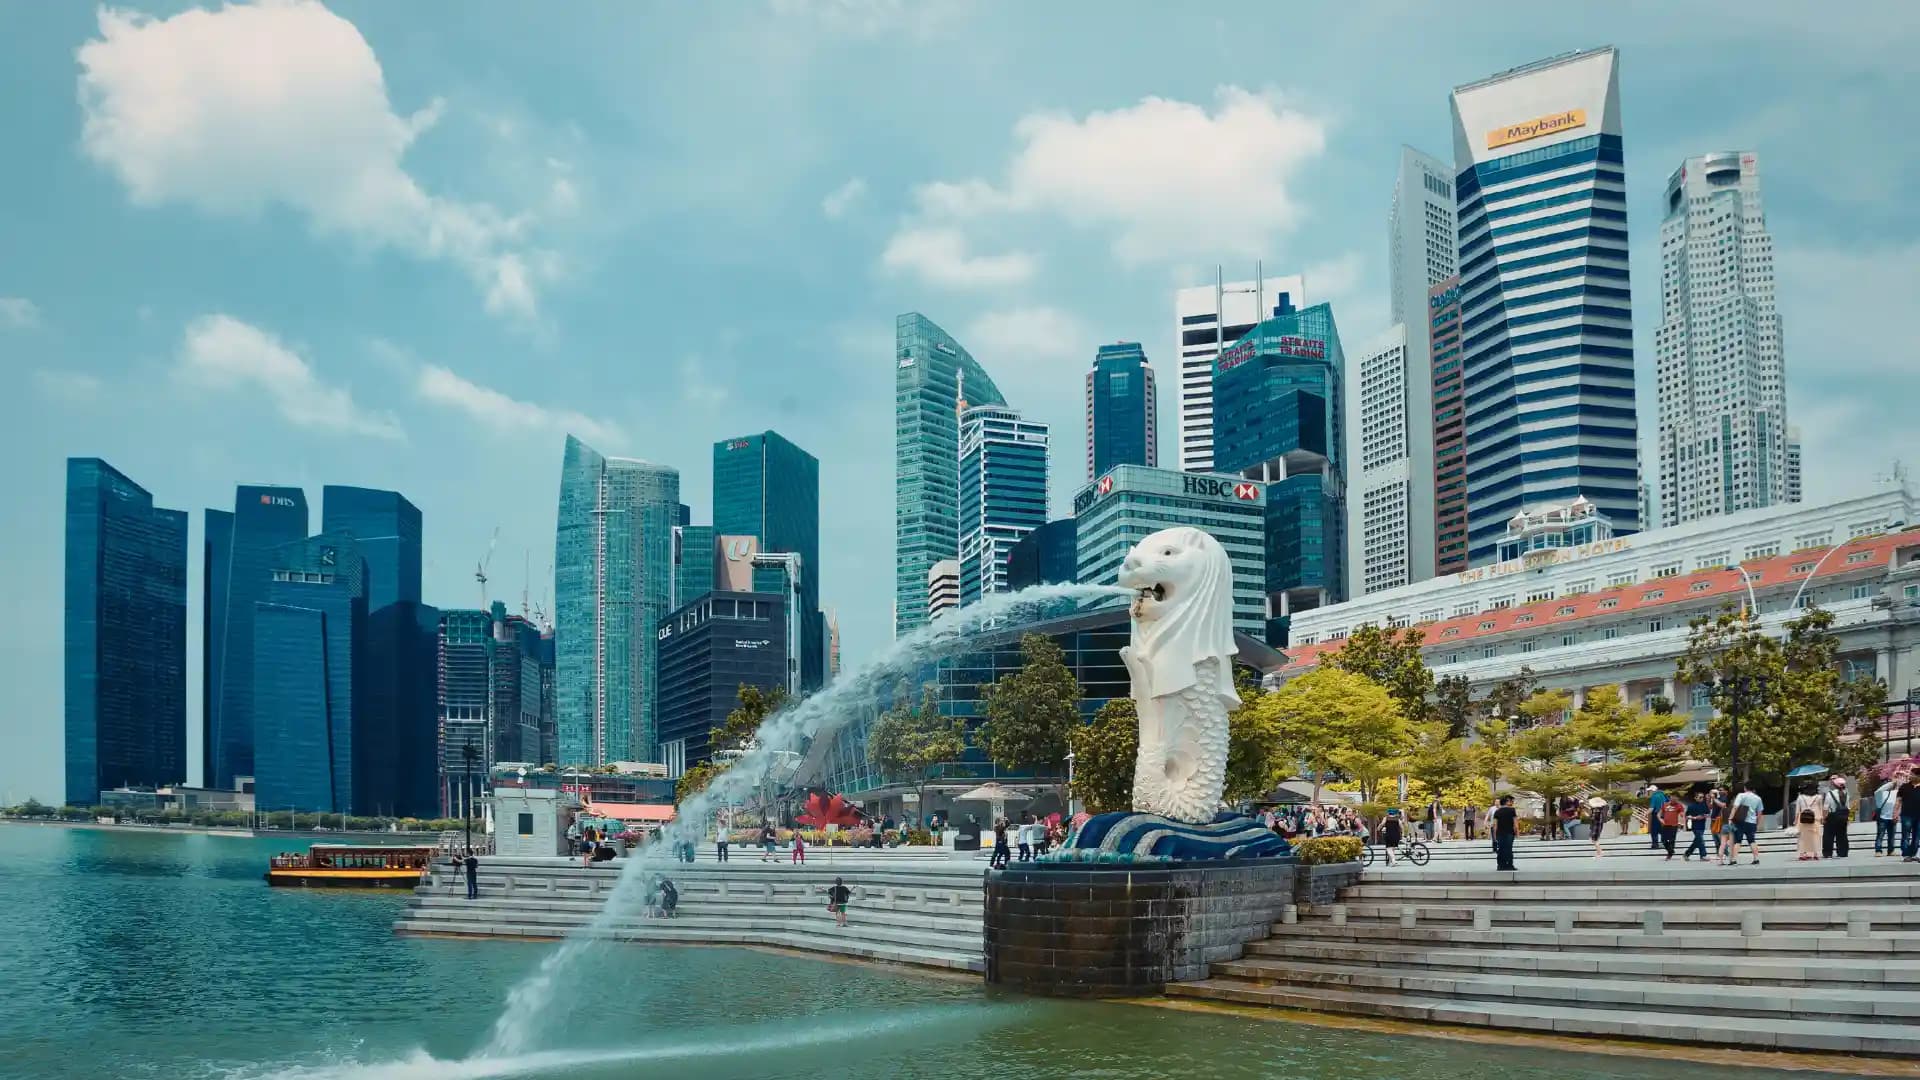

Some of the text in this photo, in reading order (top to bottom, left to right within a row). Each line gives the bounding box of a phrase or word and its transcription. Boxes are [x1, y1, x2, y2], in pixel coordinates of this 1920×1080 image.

[1507, 112, 1576, 139] Maybank
[1280, 336, 1325, 349] STRAITS
[1280, 345, 1325, 359] TRADING
[1183, 475, 1232, 498] HSBC
[272, 496, 295, 507] DBS
[1074, 483, 1099, 516] HSBC
[1458, 538, 1633, 584] THE FULLERTON HOTEL
[658, 623, 672, 641] OUE
